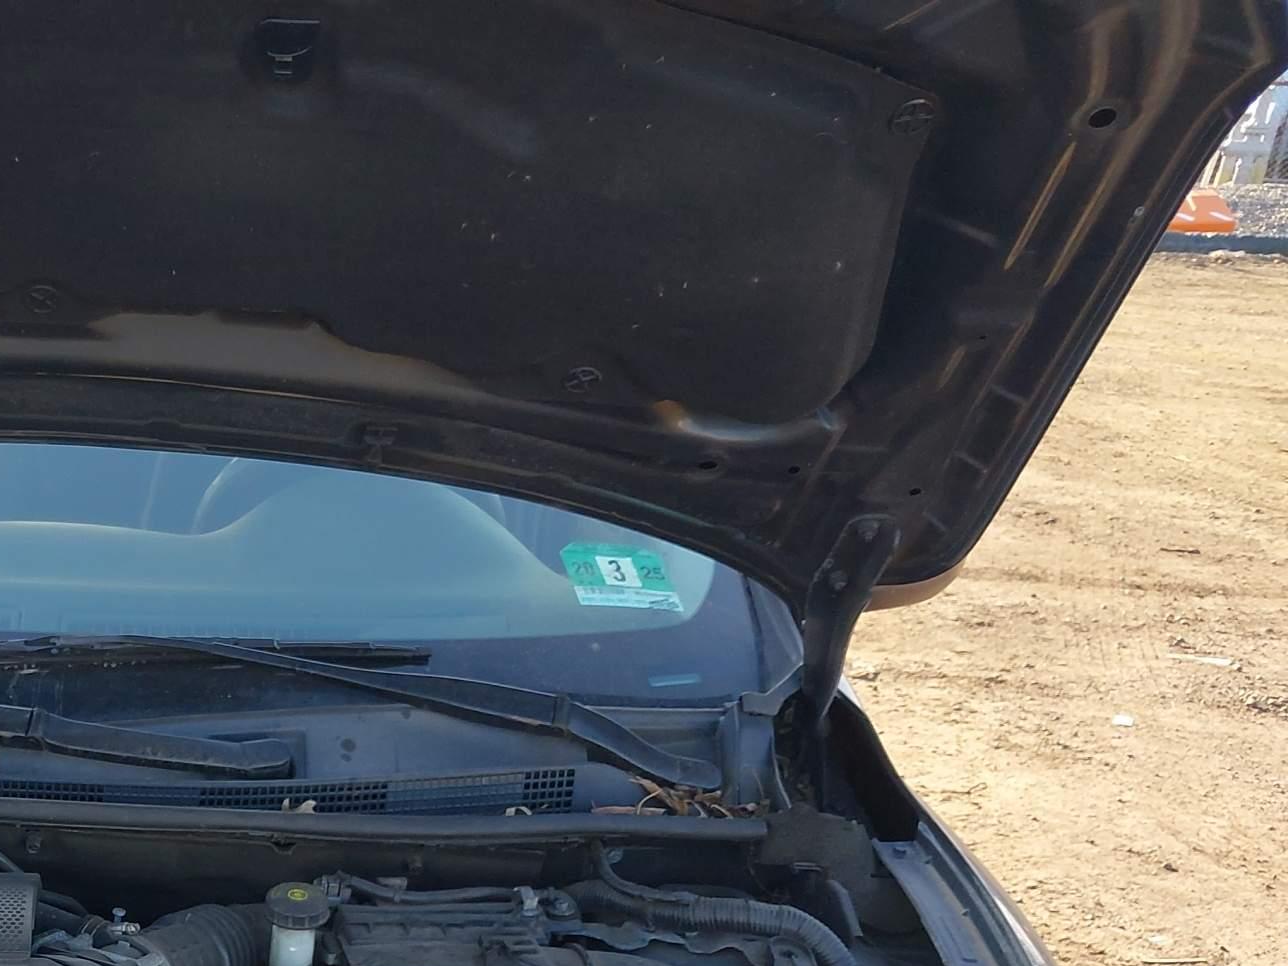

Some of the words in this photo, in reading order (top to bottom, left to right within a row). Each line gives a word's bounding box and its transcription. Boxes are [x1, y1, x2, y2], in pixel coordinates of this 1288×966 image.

[572, 562, 595, 577] 20
[607, 559, 626, 583] 3
[640, 566, 665, 581] 25
